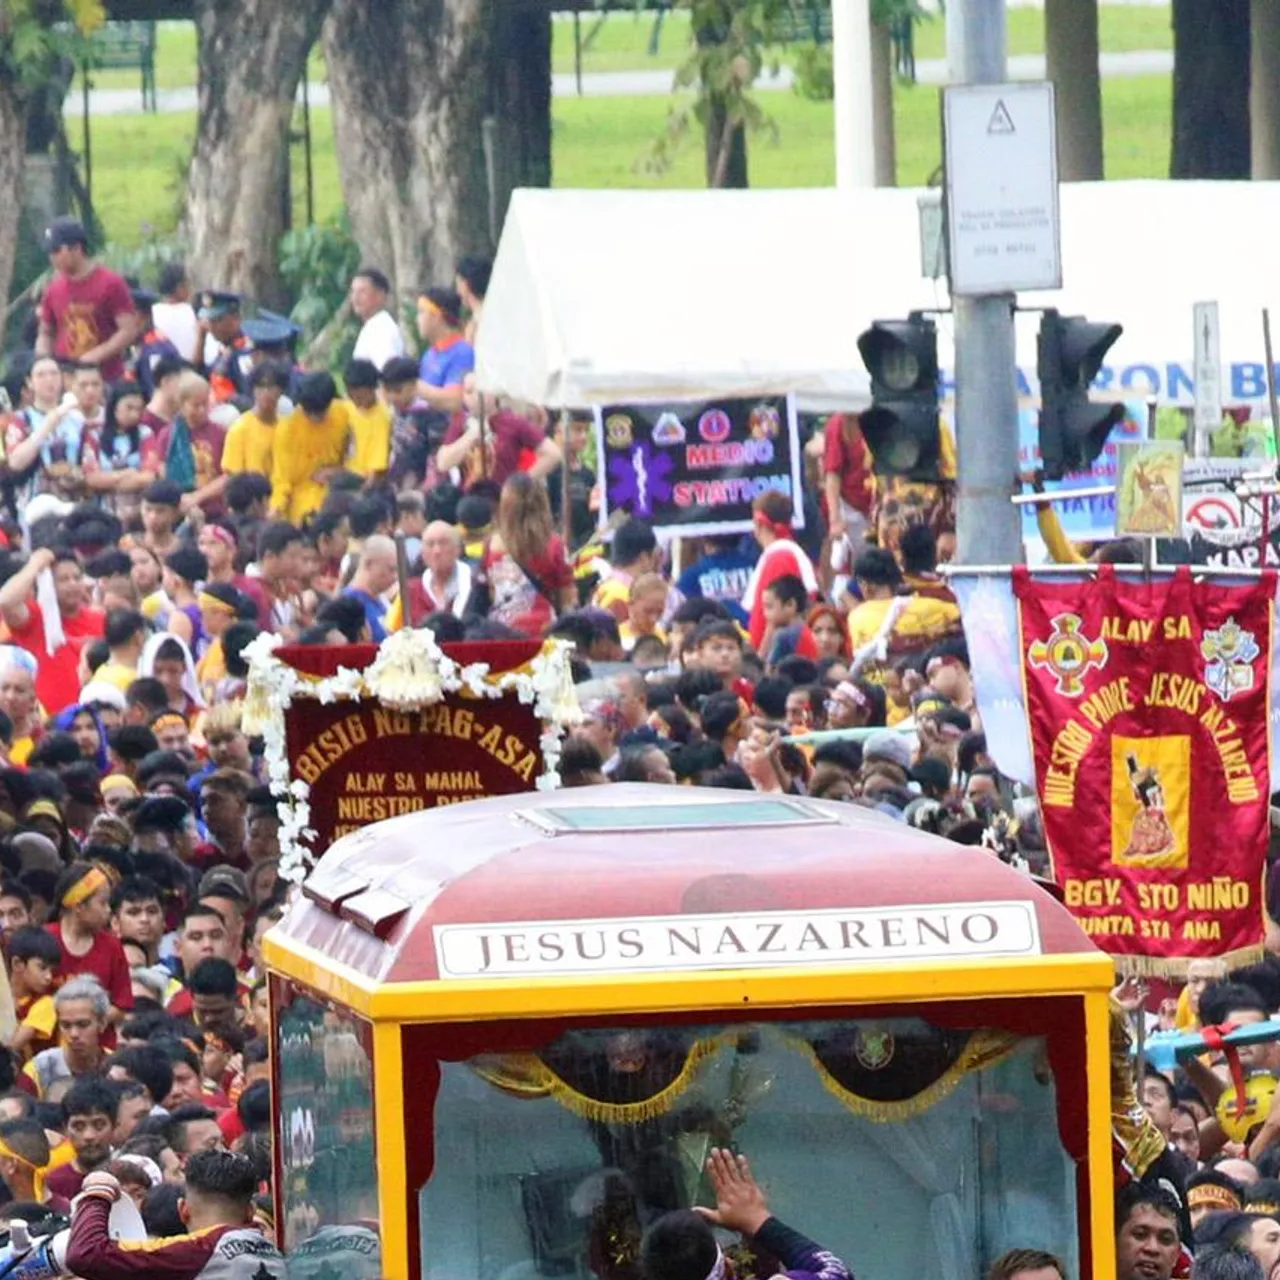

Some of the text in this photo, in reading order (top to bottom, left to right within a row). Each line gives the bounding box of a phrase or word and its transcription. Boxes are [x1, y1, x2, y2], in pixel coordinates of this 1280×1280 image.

[686, 440, 774, 469] MEDIC
[673, 474, 790, 507] STATION
[1101, 615, 1192, 642] ALAY SA
[1079, 676, 1134, 728] PADRE
[1144, 672, 1206, 715] JESUS
[296, 713, 368, 785] BISIG
[419, 706, 537, 782] PAG-ASA
[345, 770, 483, 793] ALAY SA MAHAL
[1064, 875, 1250, 910] BGY. STO NIÑO
[478, 913, 1000, 973] JESUS NAZARENO
[1141, 920, 1171, 940] STA
[1183, 920, 1221, 940] ANA
